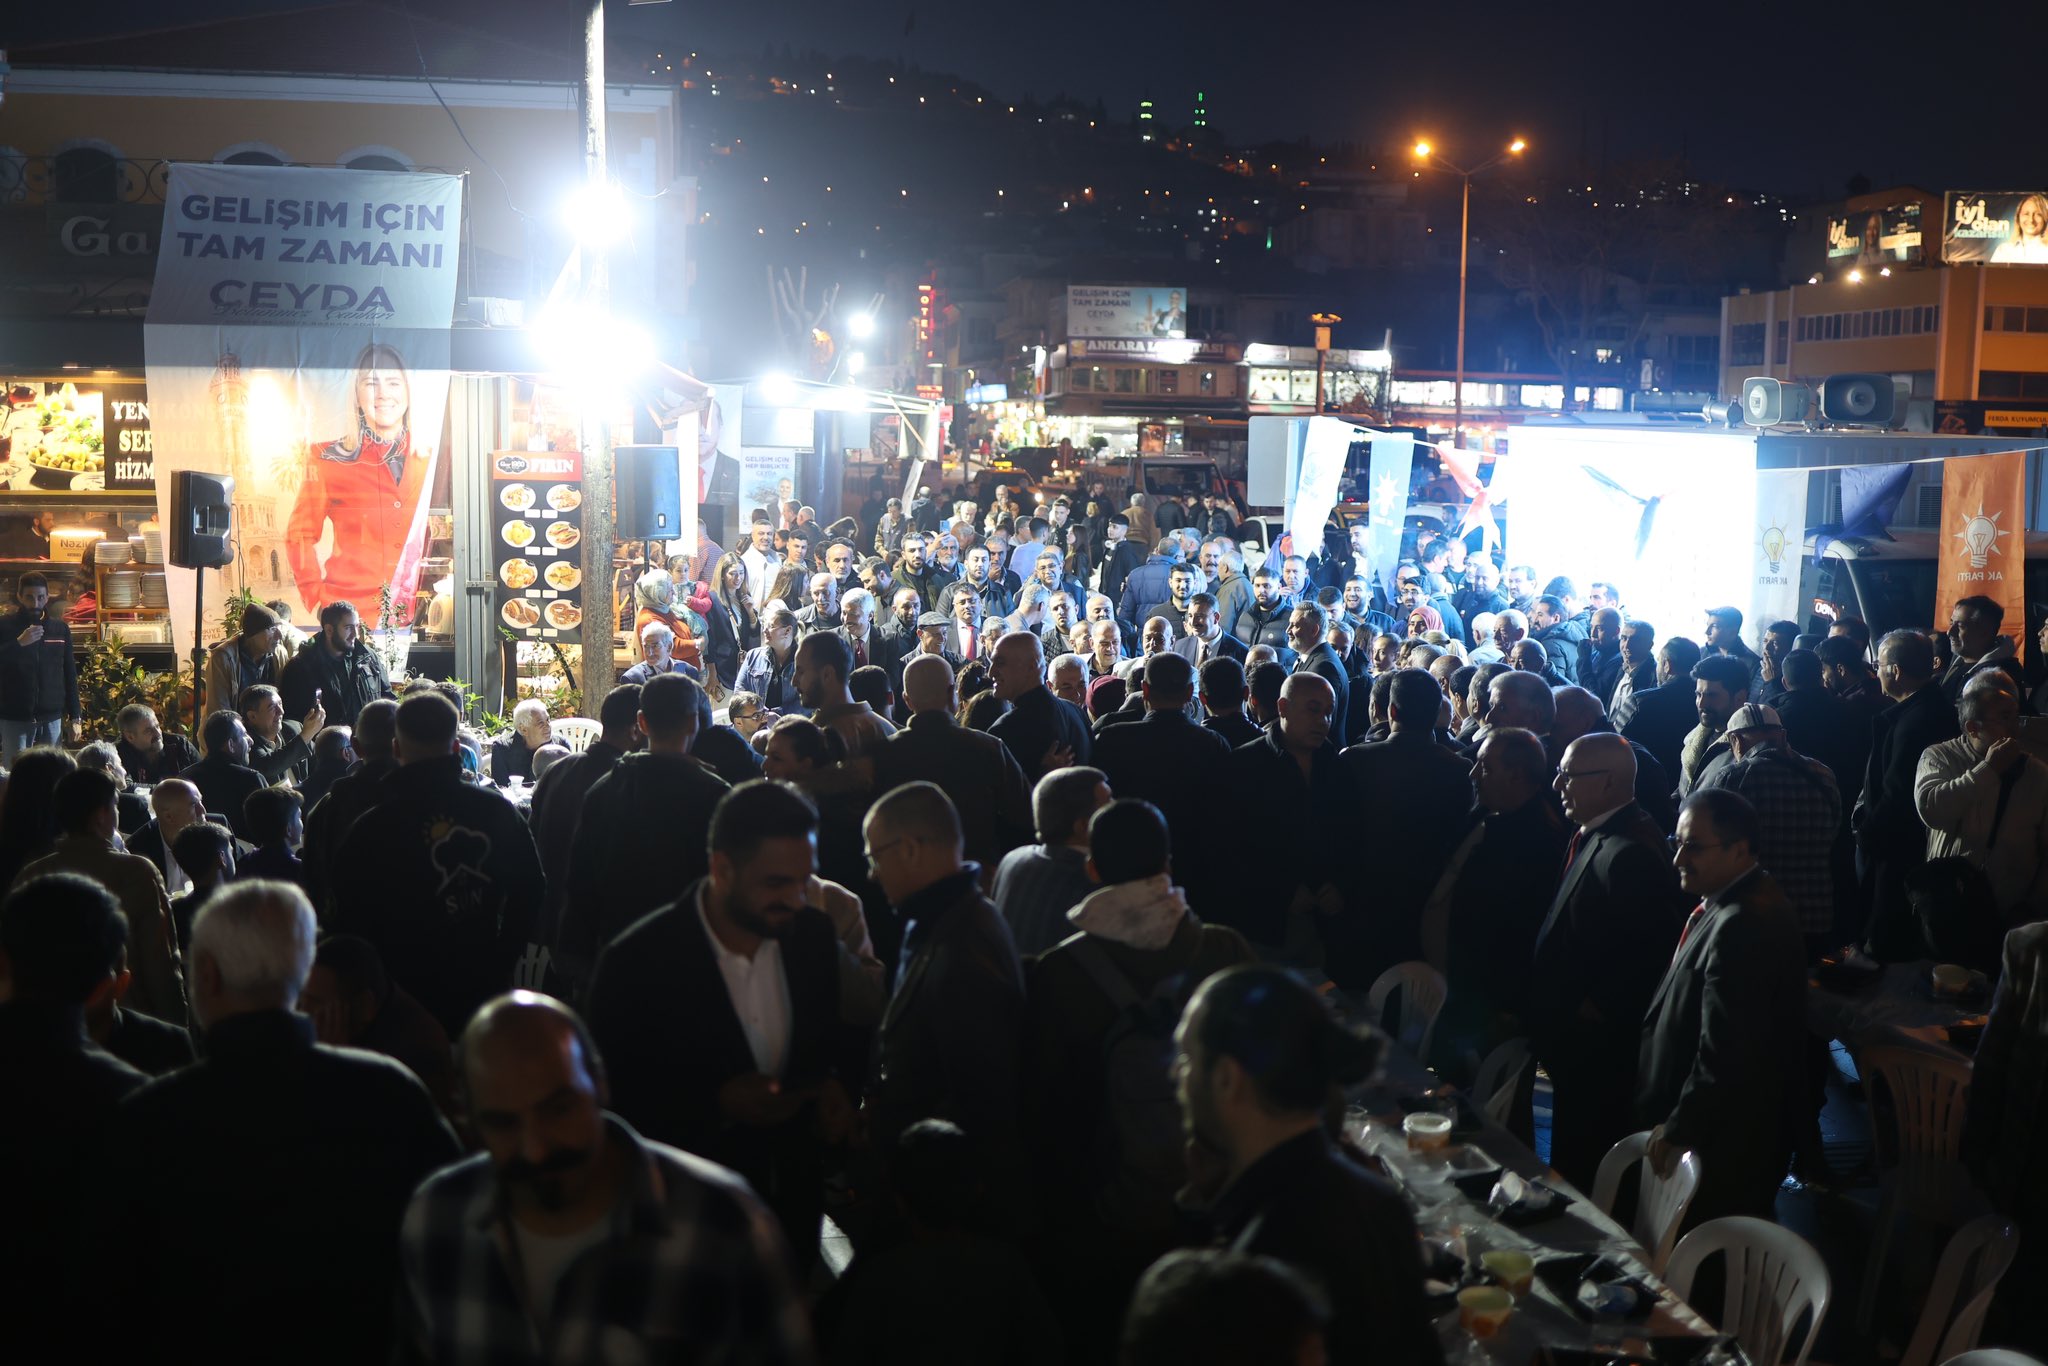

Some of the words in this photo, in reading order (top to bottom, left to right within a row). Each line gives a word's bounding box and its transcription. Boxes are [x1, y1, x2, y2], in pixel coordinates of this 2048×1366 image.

[181, 195, 347, 231] GELİŞİM
[363, 202, 444, 235] İÇİN
[1955, 199, 1986, 224] iyi
[1971, 217, 2010, 231] olan
[61, 215, 153, 257] Ga
[177, 231, 265, 261] TAM
[278, 237, 443, 268] ZAMANI
[209, 279, 395, 313] CEYDA
[1095, 299, 1131, 307] ZAMANI
[920, 295, 930, 340] OTEL
[1087, 340, 1145, 352] ANKARA
[1146, 341, 1224, 353] LTASI
[114, 457, 155, 480] HİZM
